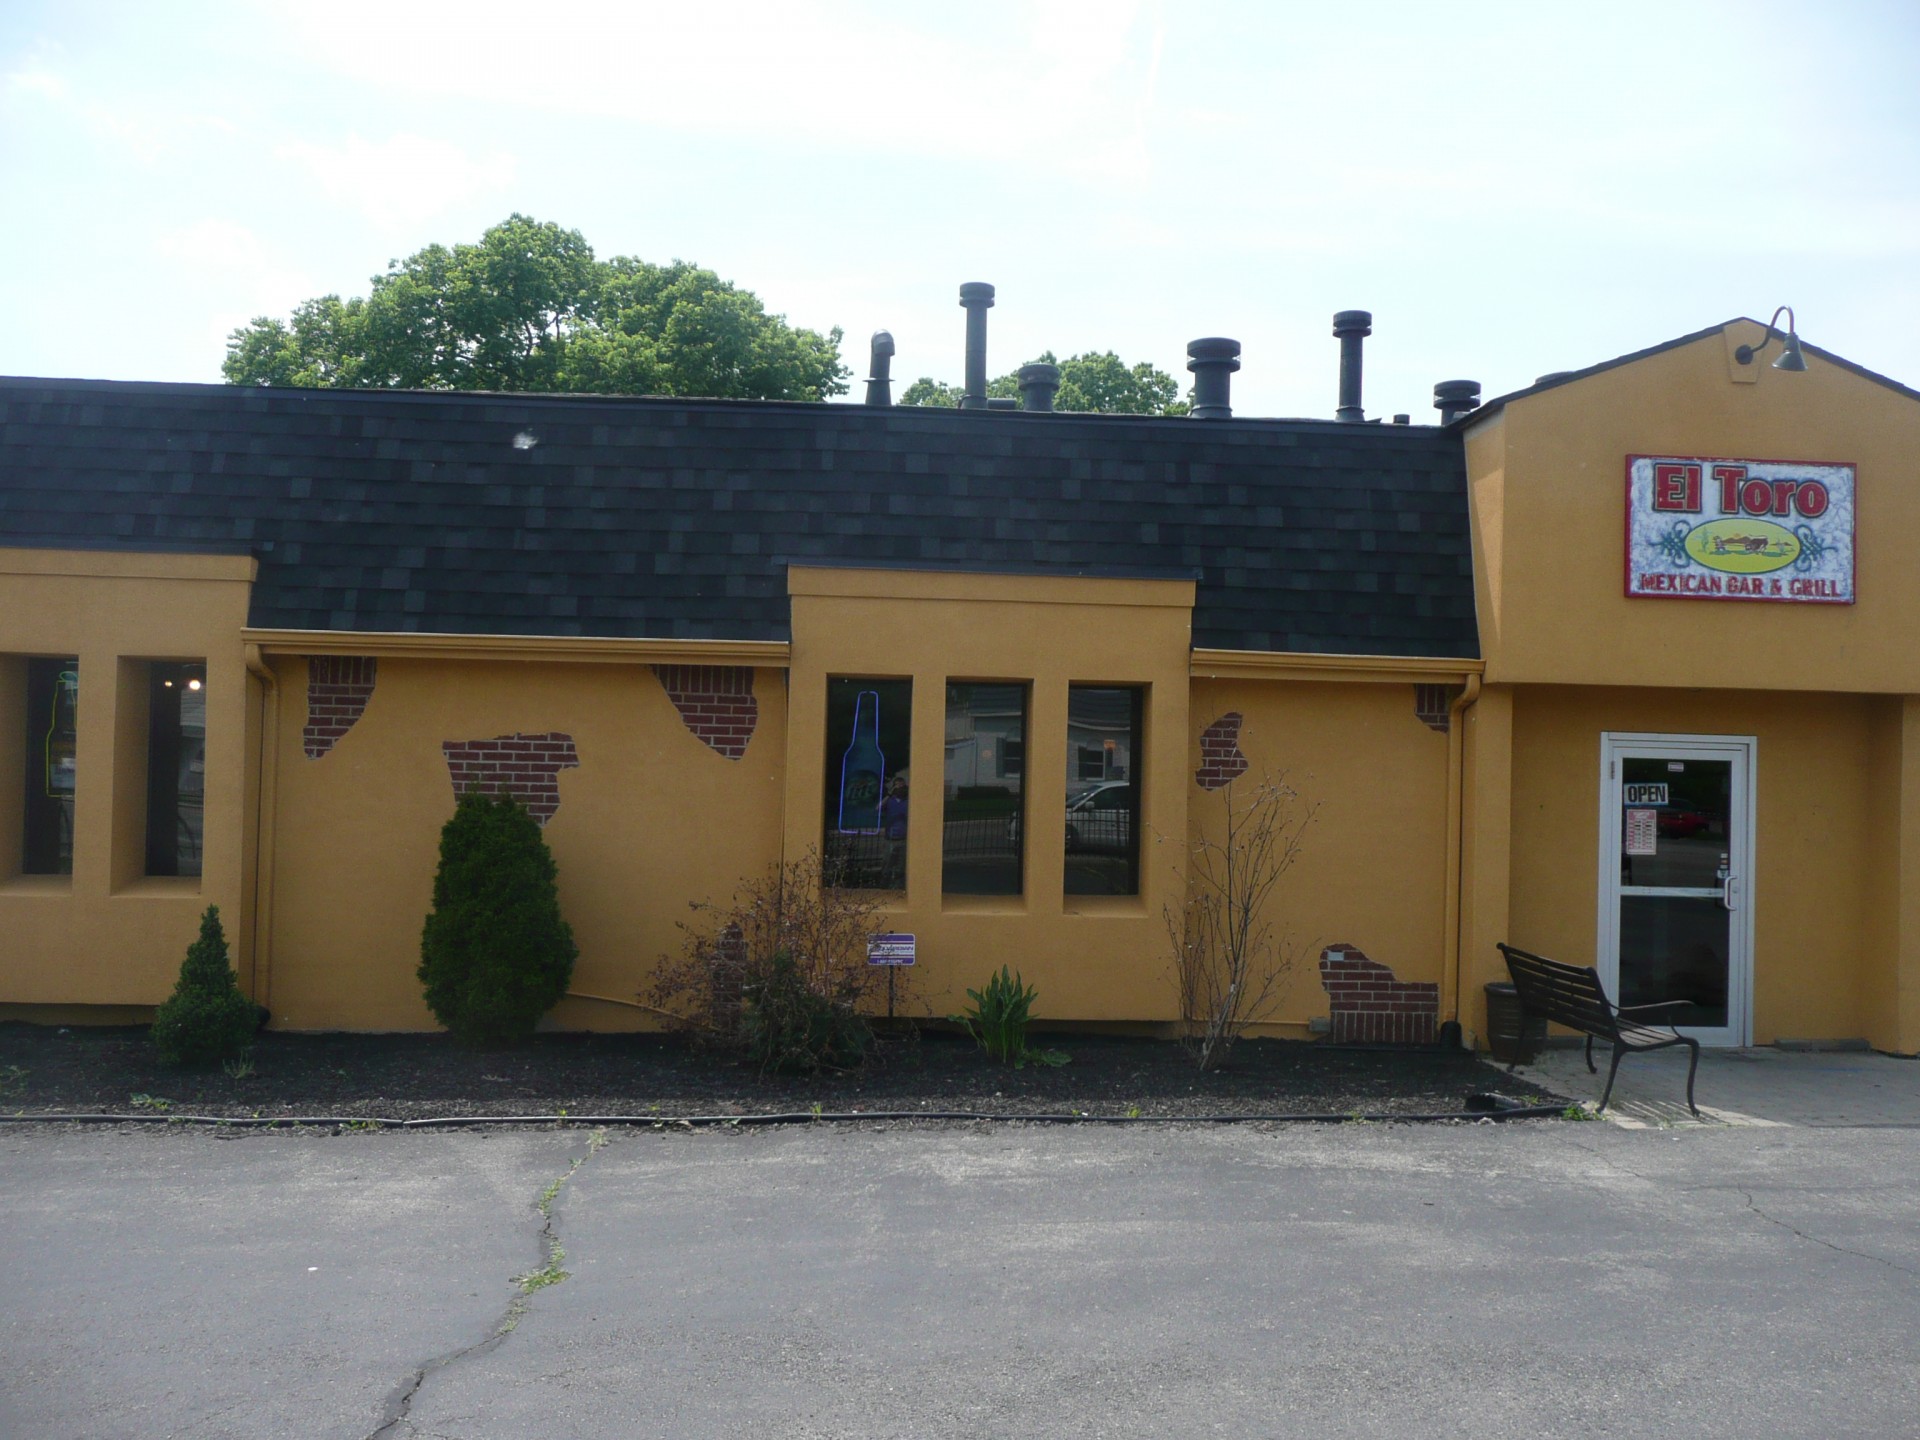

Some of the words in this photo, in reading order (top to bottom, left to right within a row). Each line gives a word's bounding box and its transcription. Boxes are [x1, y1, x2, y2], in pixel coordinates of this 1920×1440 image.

[1653, 463, 1702, 514] El
[1712, 465, 1829, 518] Toro
[1640, 573, 1722, 594] MEXICAN
[1727, 577, 1764, 595] BAR
[1771, 579, 1782, 595] &
[1789, 579, 1841, 597] GRILL
[1628, 786, 1666, 802] OPEN
